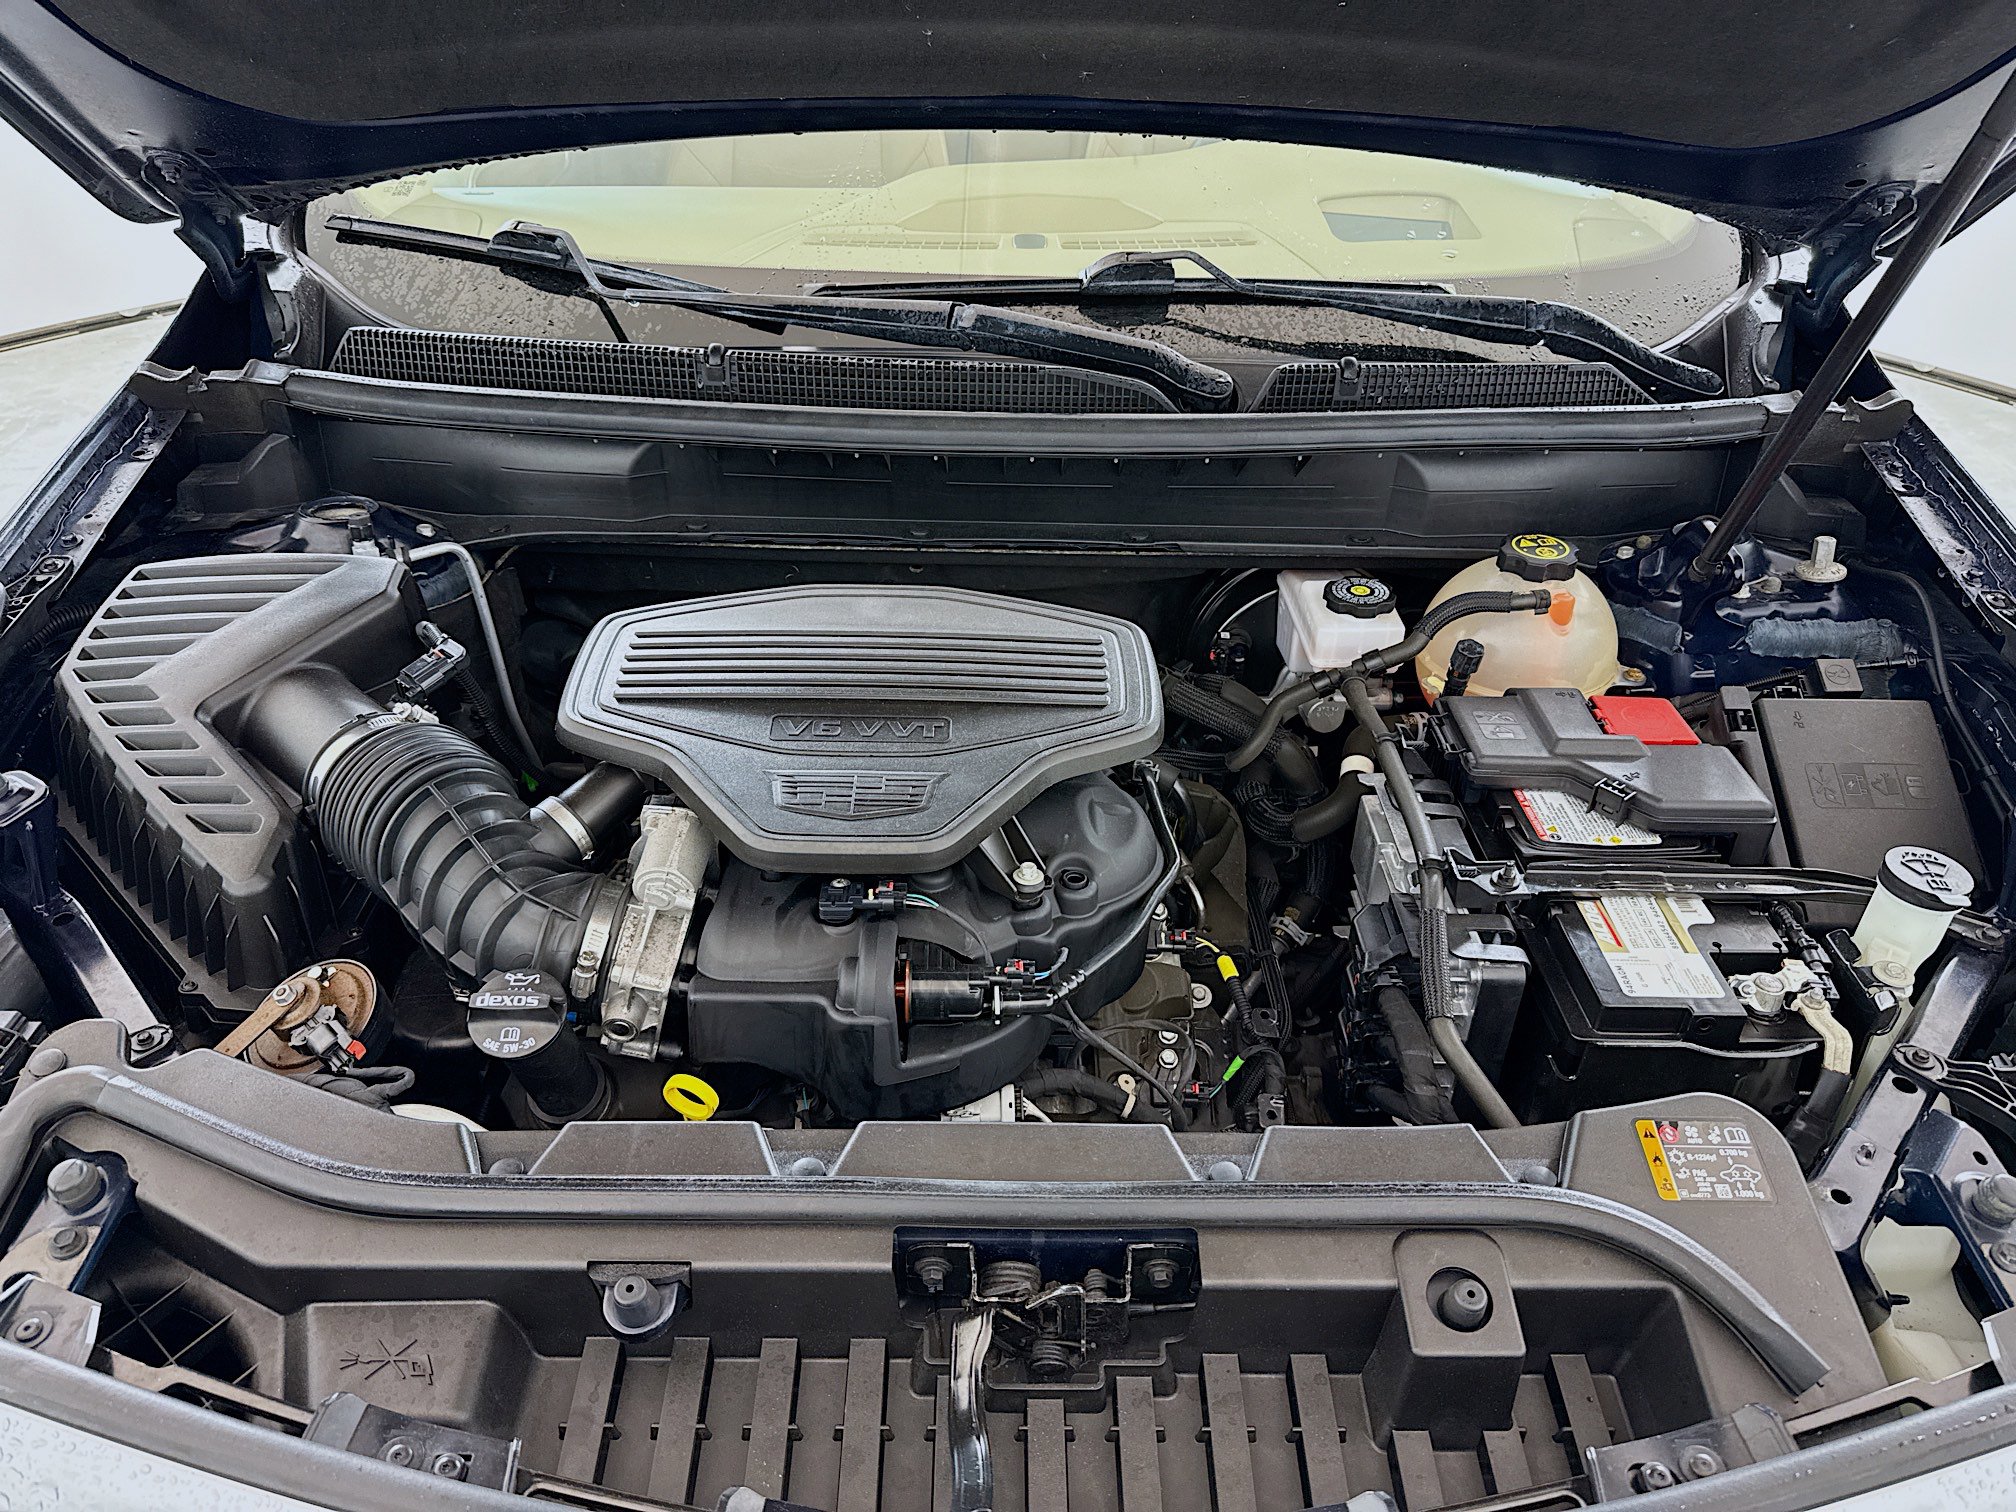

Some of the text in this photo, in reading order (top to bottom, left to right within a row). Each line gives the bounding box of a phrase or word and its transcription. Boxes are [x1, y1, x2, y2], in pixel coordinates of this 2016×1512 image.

[779, 719, 945, 738] V6 VVT
[1615, 965, 1637, 994] 94RAGM
[475, 992, 541, 1007] dexos
[483, 1037, 536, 1053] SAE 5W-30
[1739, 1149, 1748, 1157] kg
[1754, 1191, 1765, 1199] kg
